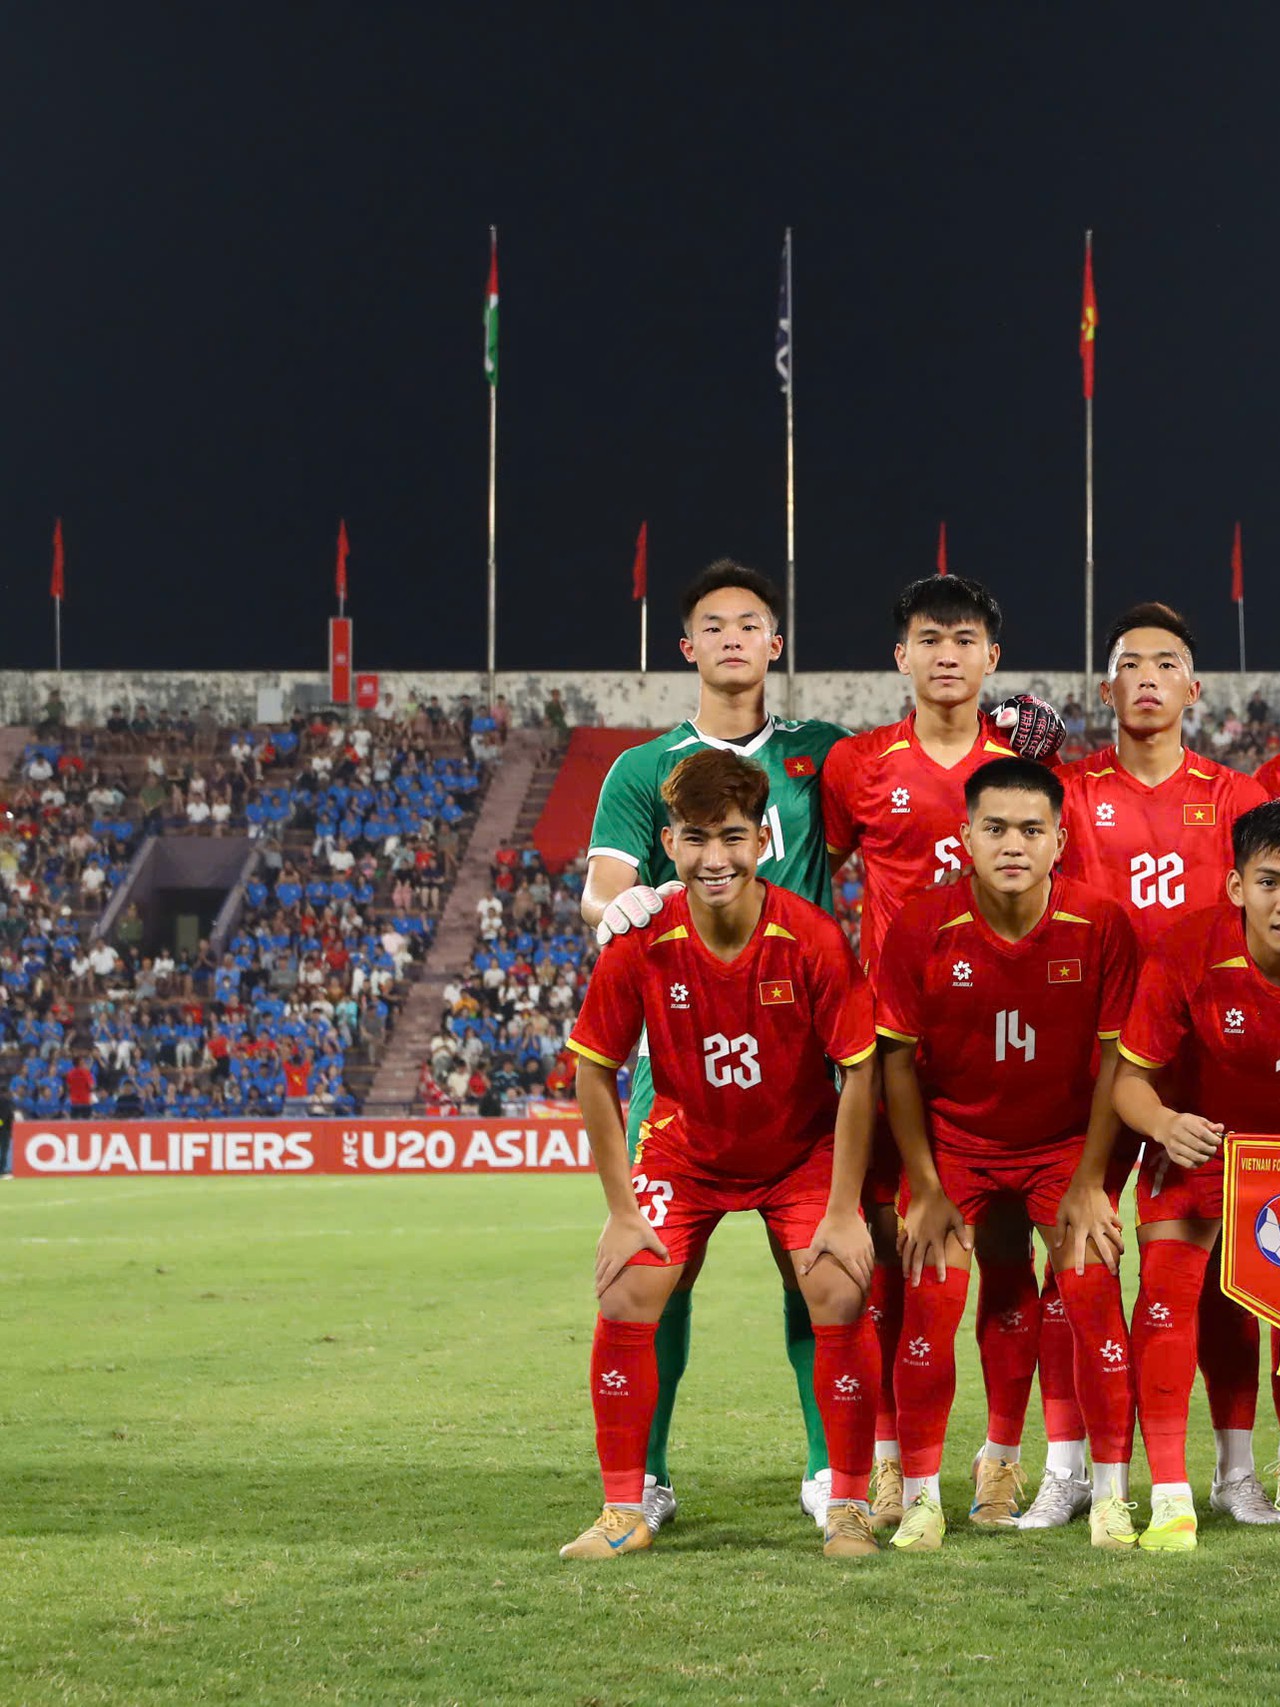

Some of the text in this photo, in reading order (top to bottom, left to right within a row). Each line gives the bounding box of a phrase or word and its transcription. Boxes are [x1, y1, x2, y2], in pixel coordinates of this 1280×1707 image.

[934, 835, 961, 883] 5
[1130, 851, 1185, 909] 22
[995, 1009, 1036, 1062] 14
[703, 1032, 762, 1089] 23
[24, 1132, 314, 1171] QUALIFIERS
[343, 1132, 358, 1167] AFC
[362, 1130, 456, 1168] U20
[1241, 1158, 1271, 1170] VIETNAM
